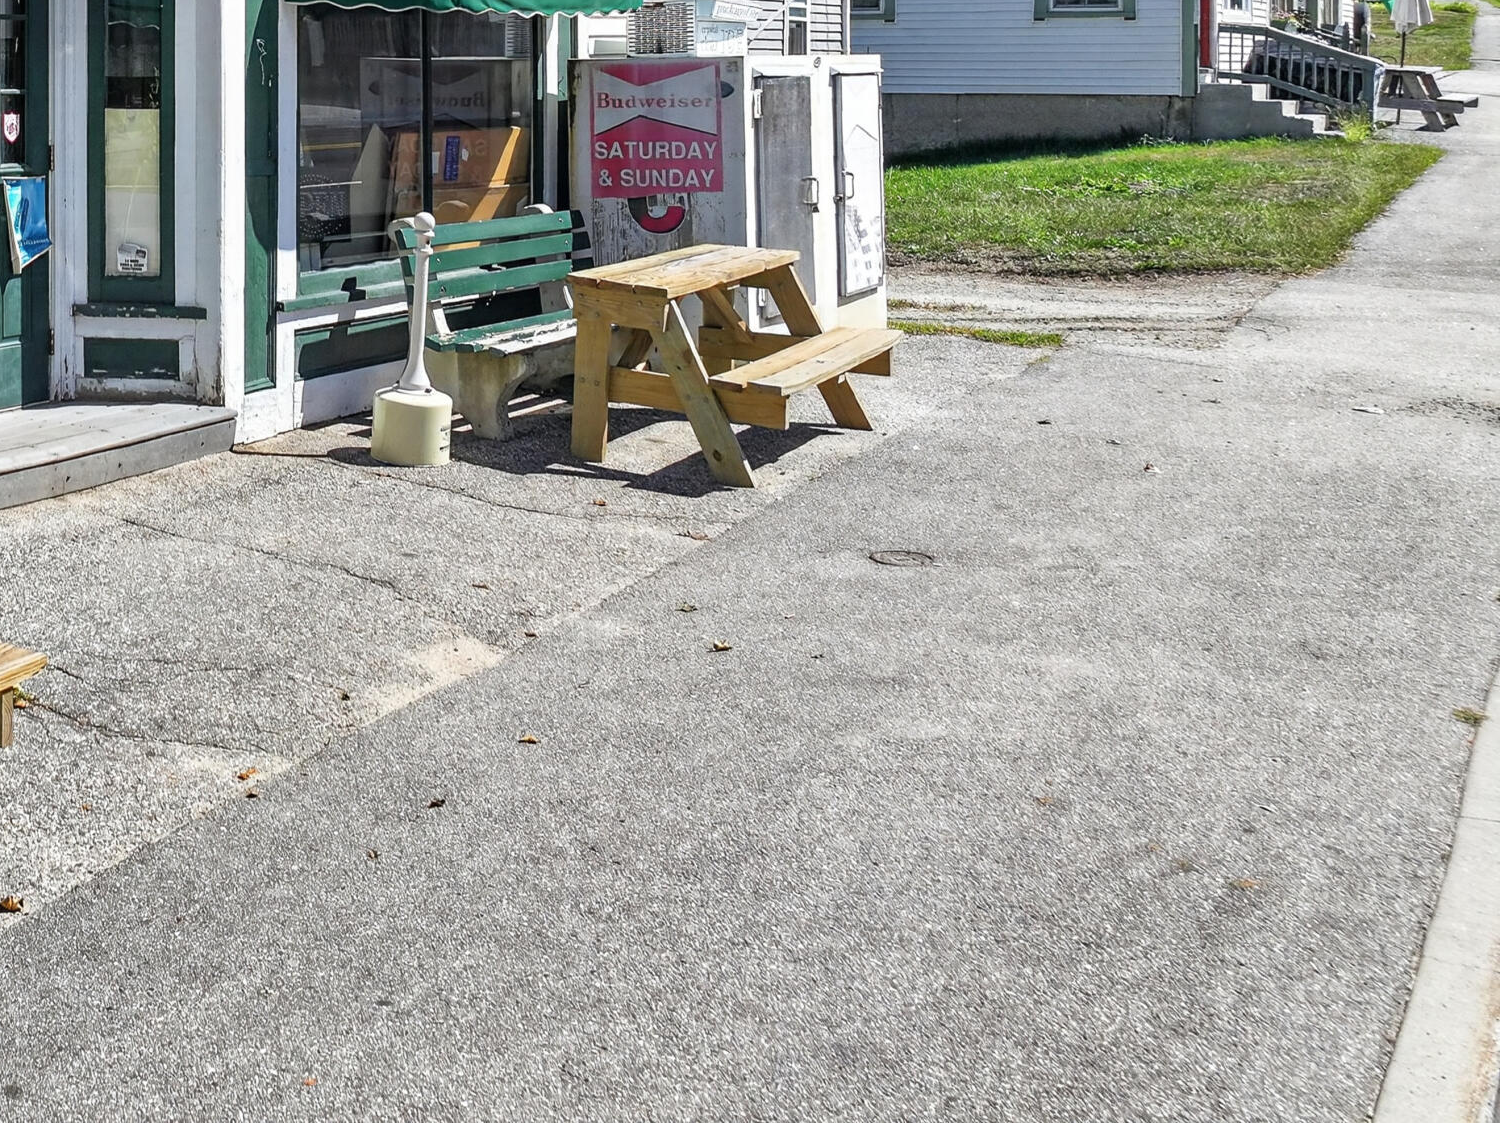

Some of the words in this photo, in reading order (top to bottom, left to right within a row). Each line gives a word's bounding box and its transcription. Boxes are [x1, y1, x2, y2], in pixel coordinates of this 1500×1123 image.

[596, 92, 713, 109] Budweiser
[594, 141, 718, 160] SATURDAY
[599, 169, 613, 187] &
[620, 168, 715, 188] SUNDAY
